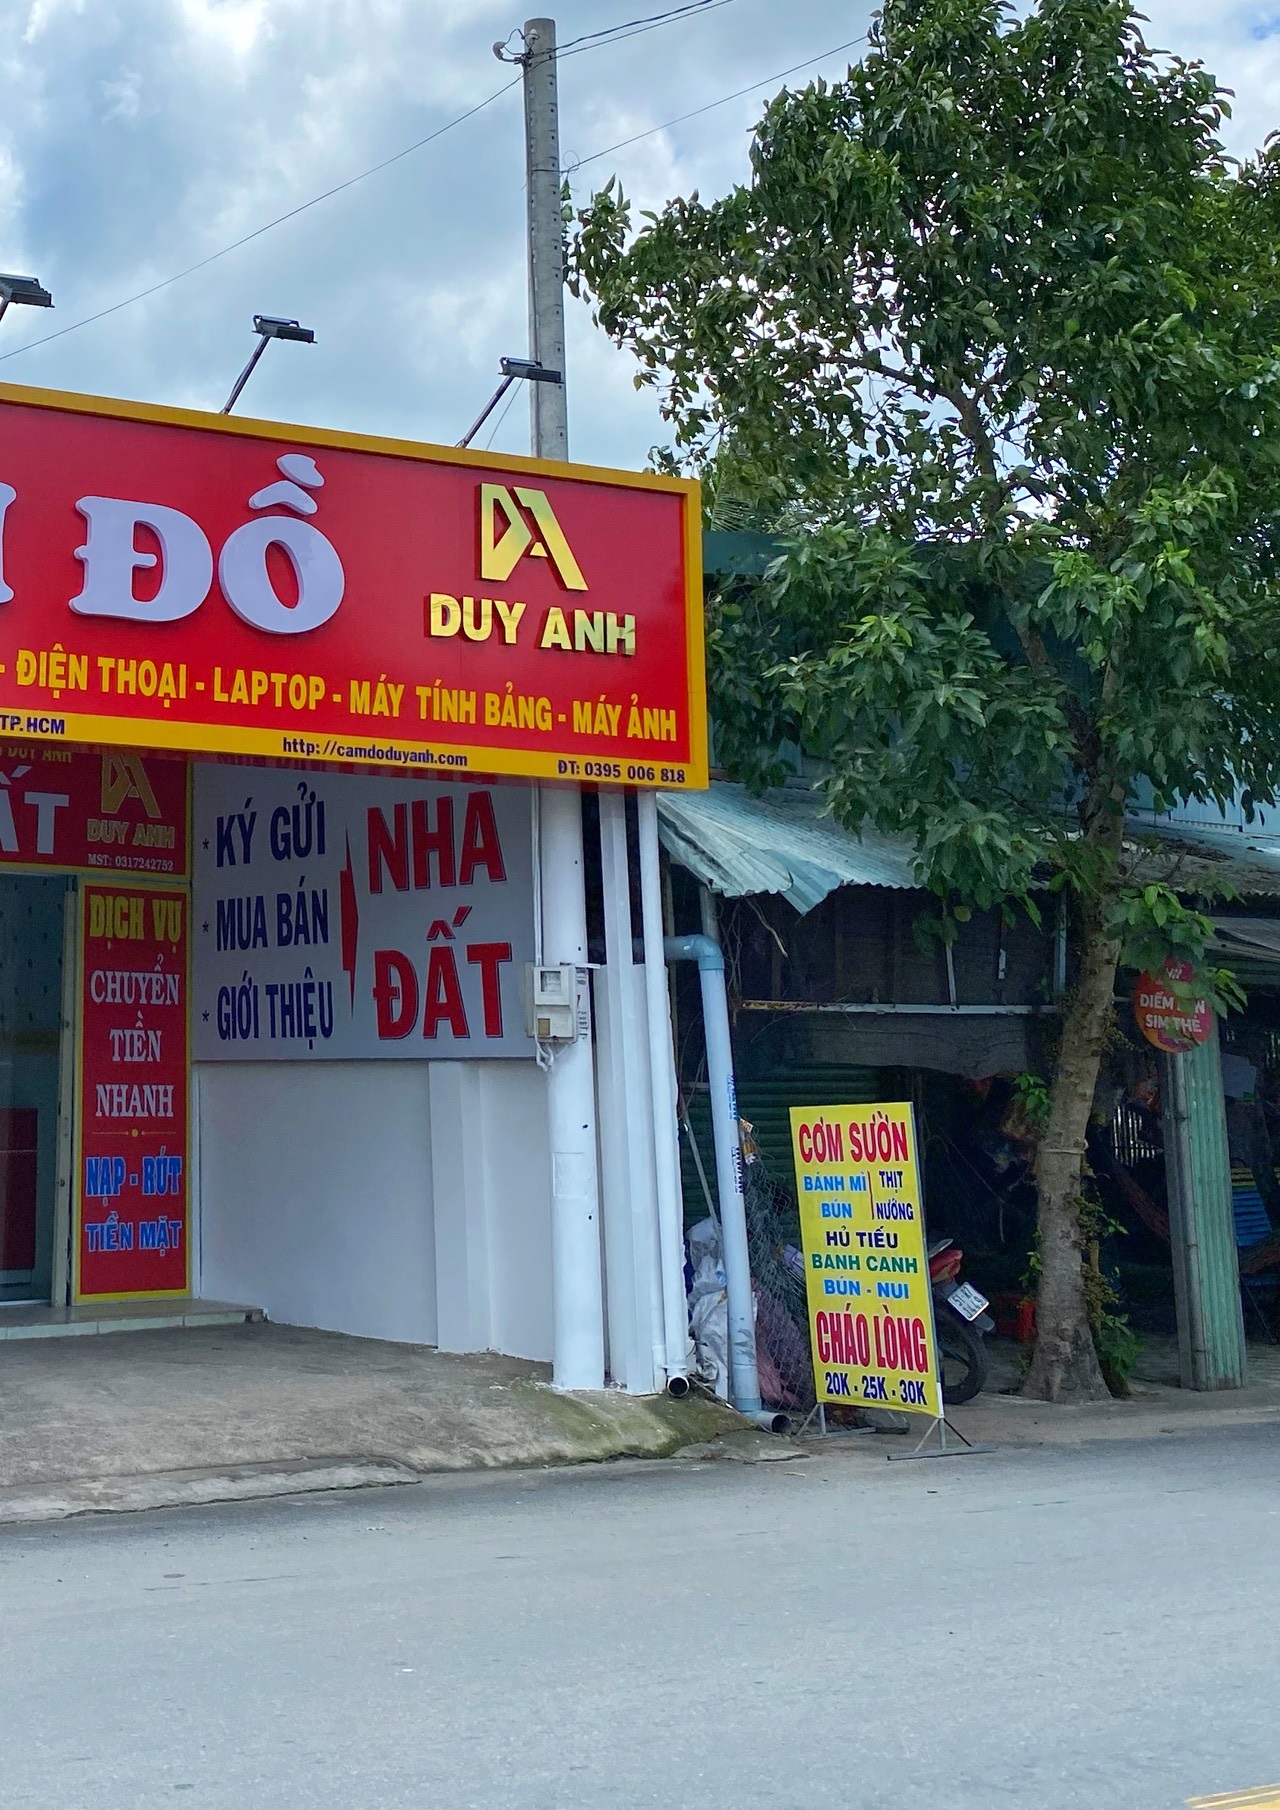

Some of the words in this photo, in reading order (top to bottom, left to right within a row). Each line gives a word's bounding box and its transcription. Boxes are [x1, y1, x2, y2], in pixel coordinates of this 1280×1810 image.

[68, 453, 345, 634] ĐỒ
[430, 593, 526, 644] DUY
[540, 607, 636, 655] ANH
[16, 644, 88, 698] ĐIỆN
[98, 657, 186, 708] THOẠI
[214, 667, 326, 710] LAPTOP
[350, 674, 404, 717] MÁY
[416, 679, 476, 724] TÍNH
[484, 681, 552, 731] BẢNG
[573, 695, 621, 736] MÁY
[627, 693, 676, 741] ẢNH
[0, 714, 65, 735] TP.HCM
[558, 760, 580, 776] ĐT:
[584, 762, 621, 778] 0395
[628, 766, 655, 781] 006
[660, 768, 686, 783] 818
[87, 819, 130, 844] DUY
[132, 823, 175, 849] ANH
[216, 797, 257, 867] KÝ
[270, 781, 325, 860] GỬI
[88, 853, 112, 866] MST:
[89, 895, 145, 950] DỊCH
[152, 899, 182, 953] VỤ
[216, 896, 268, 951] MUA
[277, 875, 328, 946] BÁN
[90, 953, 180, 1005] CHUYỂN
[373, 905, 512, 1040] ĐẤT
[218, 970, 259, 1040] GIỚI
[265, 966, 333, 1050] THIỆU
[109, 1010, 161, 1062] TIỀN
[96, 1084, 174, 1117] NHANH
[799, 1116, 844, 1163] CƠM
[849, 1111, 909, 1162] SƯỜN
[86, 1157, 126, 1207] NẠP
[142, 1146, 182, 1195] RÚT
[803, 1171, 845, 1191] BÁNH
[849, 1170, 868, 1191] MÌ
[878, 1170, 903, 1193] THỊT
[821, 1198, 852, 1218] BÚN
[876, 1198, 914, 1220] NƯỚNG
[85, 1211, 133, 1252] TIỀN
[139, 1216, 182, 1257] MẶT
[826, 1225, 850, 1247] HỦ
[856, 1225, 898, 1248] TIẾU
[866, 1255, 918, 1273] CANH
[824, 1276, 861, 1296] BÚN
[877, 1282, 909, 1299] NUI
[816, 1303, 870, 1367] CHÁO
[873, 1304, 928, 1373] LÒNG
[825, 1372, 851, 1396] 20K
[862, 1375, 888, 1400] 25K
[899, 1379, 927, 1405] 30K
